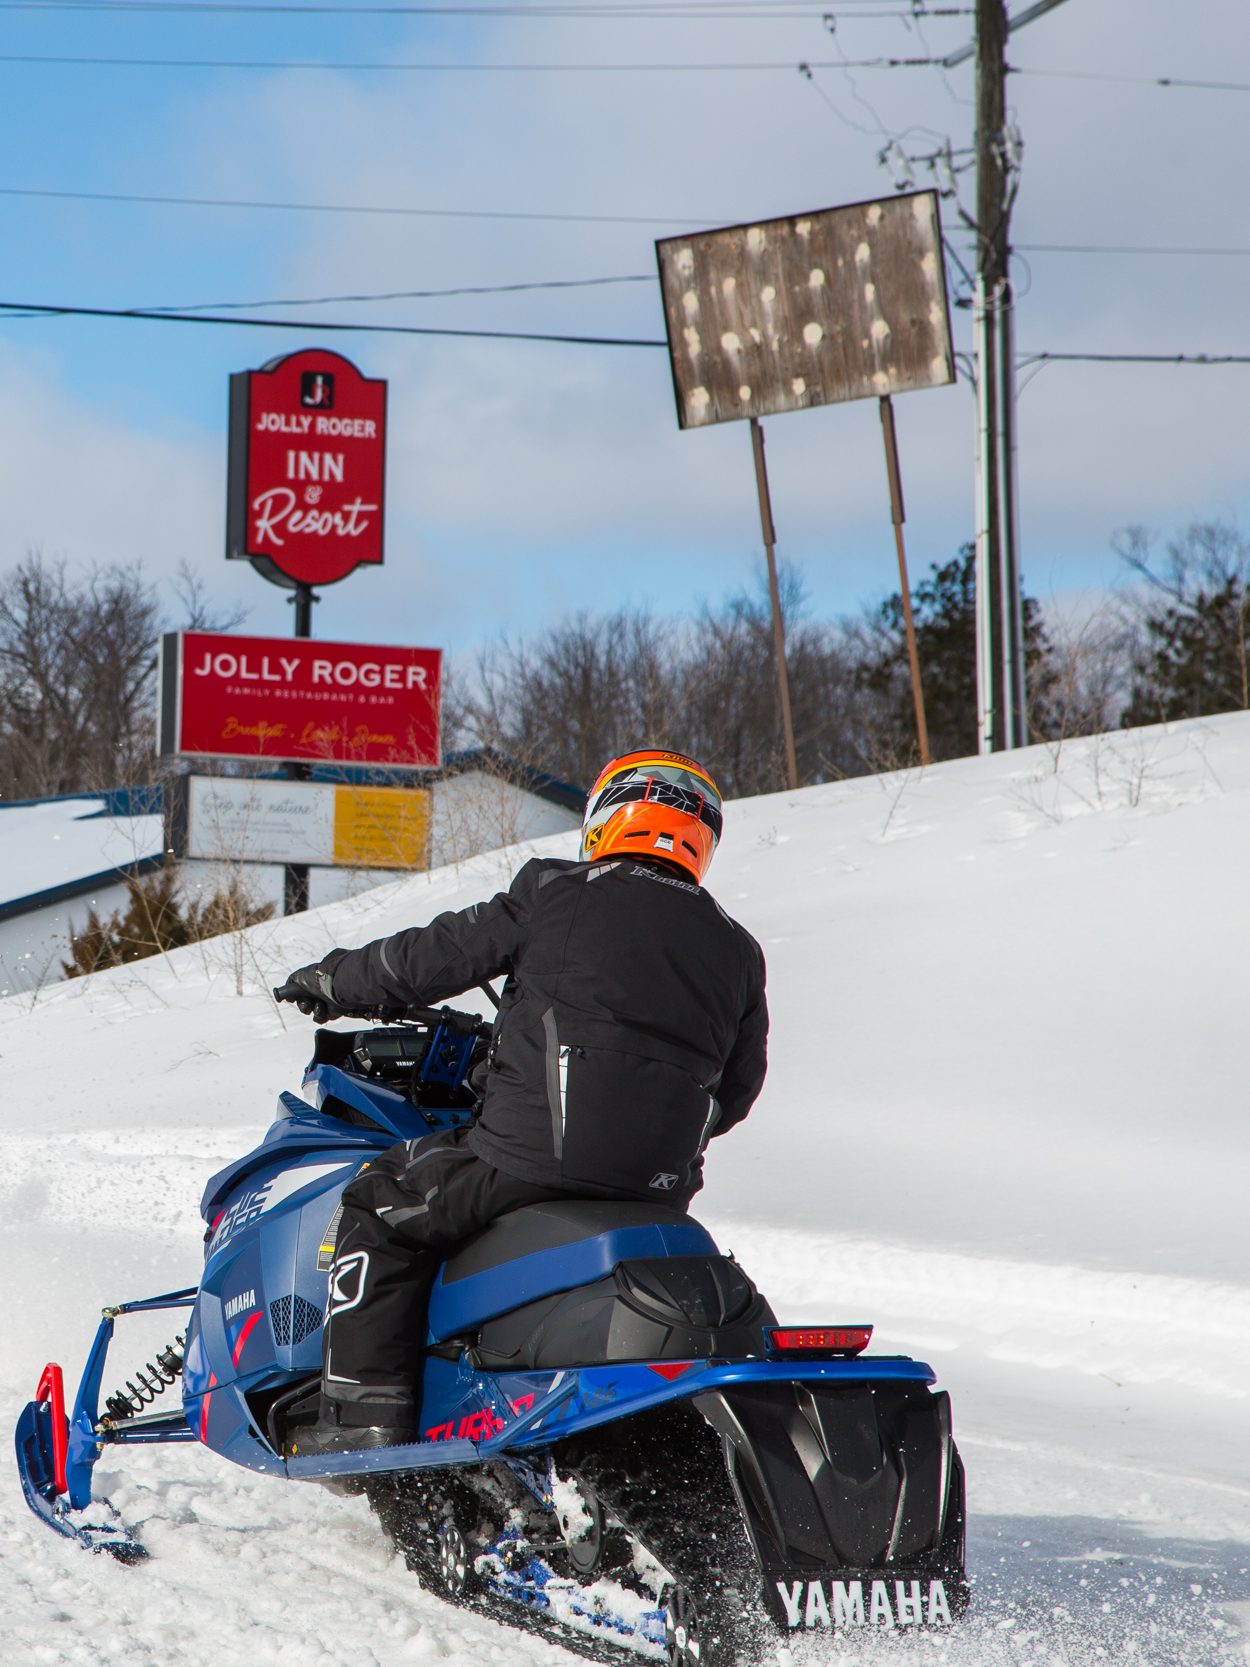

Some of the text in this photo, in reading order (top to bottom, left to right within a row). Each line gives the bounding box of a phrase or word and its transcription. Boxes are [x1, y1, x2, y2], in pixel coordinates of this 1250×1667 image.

[256, 412, 376, 439] JOLLY ROGER
[287, 449, 344, 483] INN
[304, 485, 322, 504] &
[253, 487, 378, 546] Resort
[194, 652, 428, 690] JOLLY ROGER
[226, 685, 271, 697] FAMILY
[274, 688, 354, 703] RESTAURANT
[369, 694, 395, 705] BAR
[224, 1289, 256, 1321] YAMAHA
[776, 1580, 953, 1628] YAMAHA
